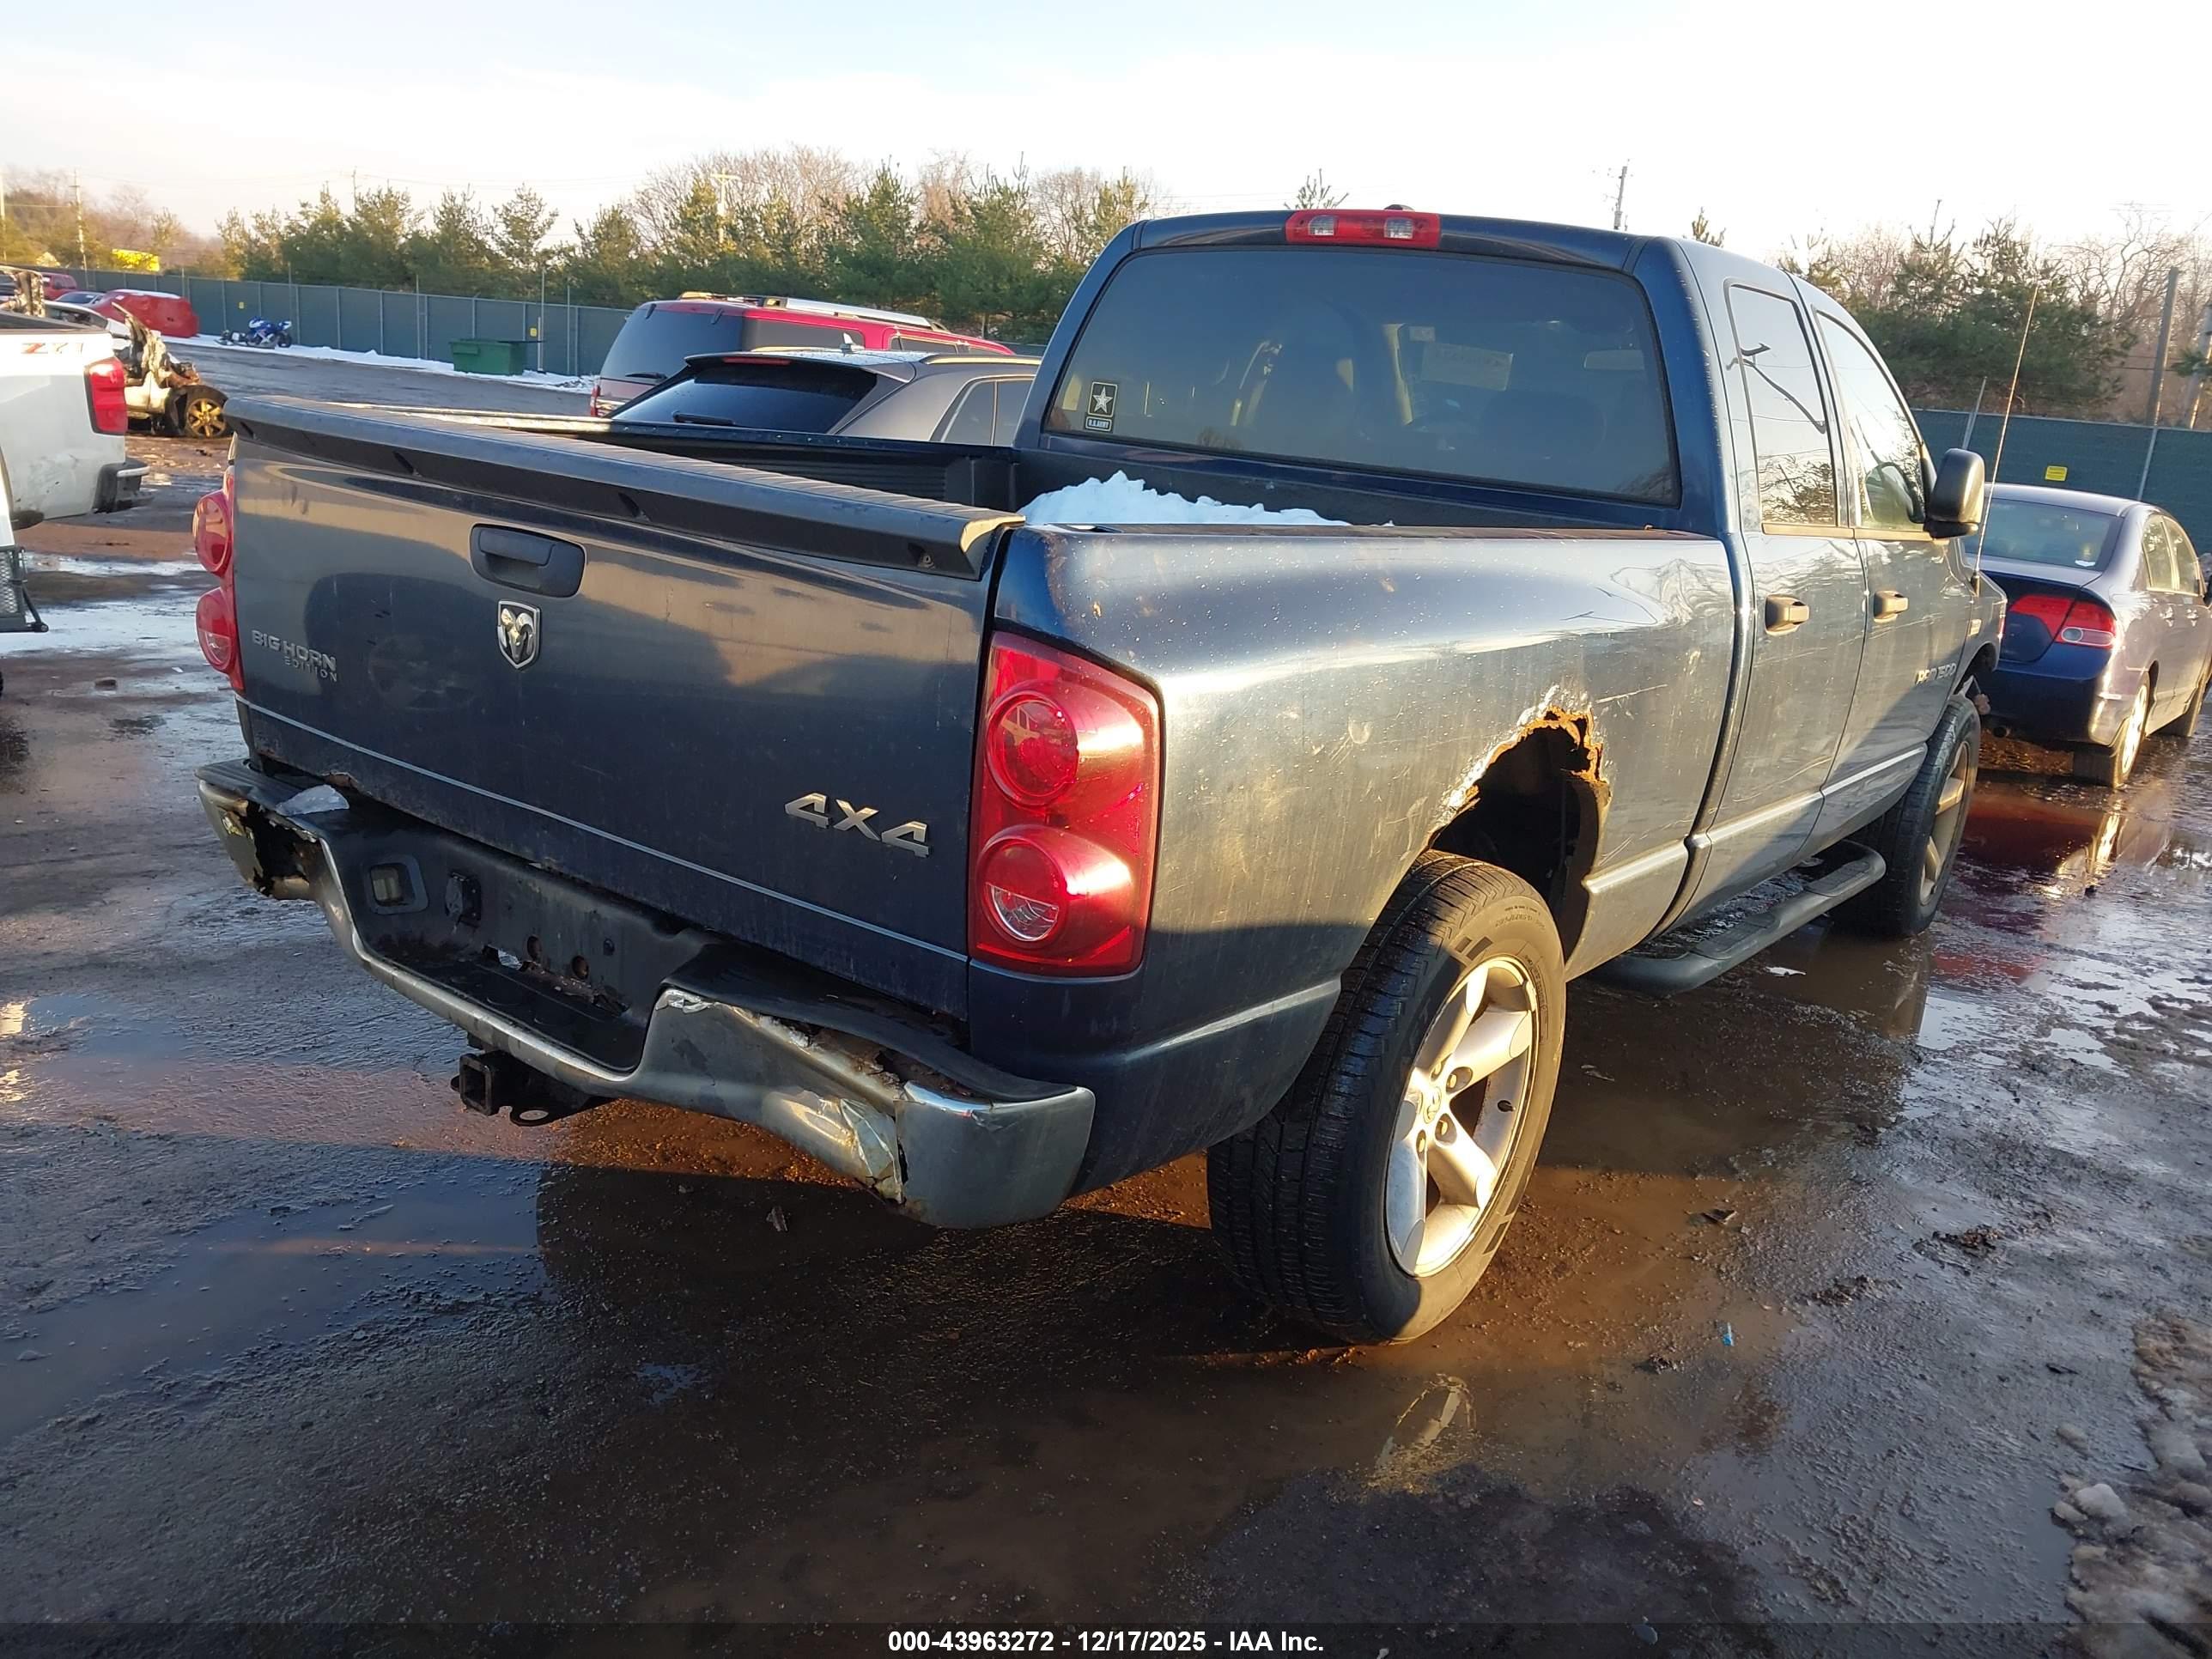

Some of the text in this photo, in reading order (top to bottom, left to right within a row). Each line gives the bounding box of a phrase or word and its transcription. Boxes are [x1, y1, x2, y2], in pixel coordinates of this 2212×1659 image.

[252, 629, 337, 672] BIG HORN
[284, 655, 337, 683] EDITION
[784, 792, 930, 859] 4X4
